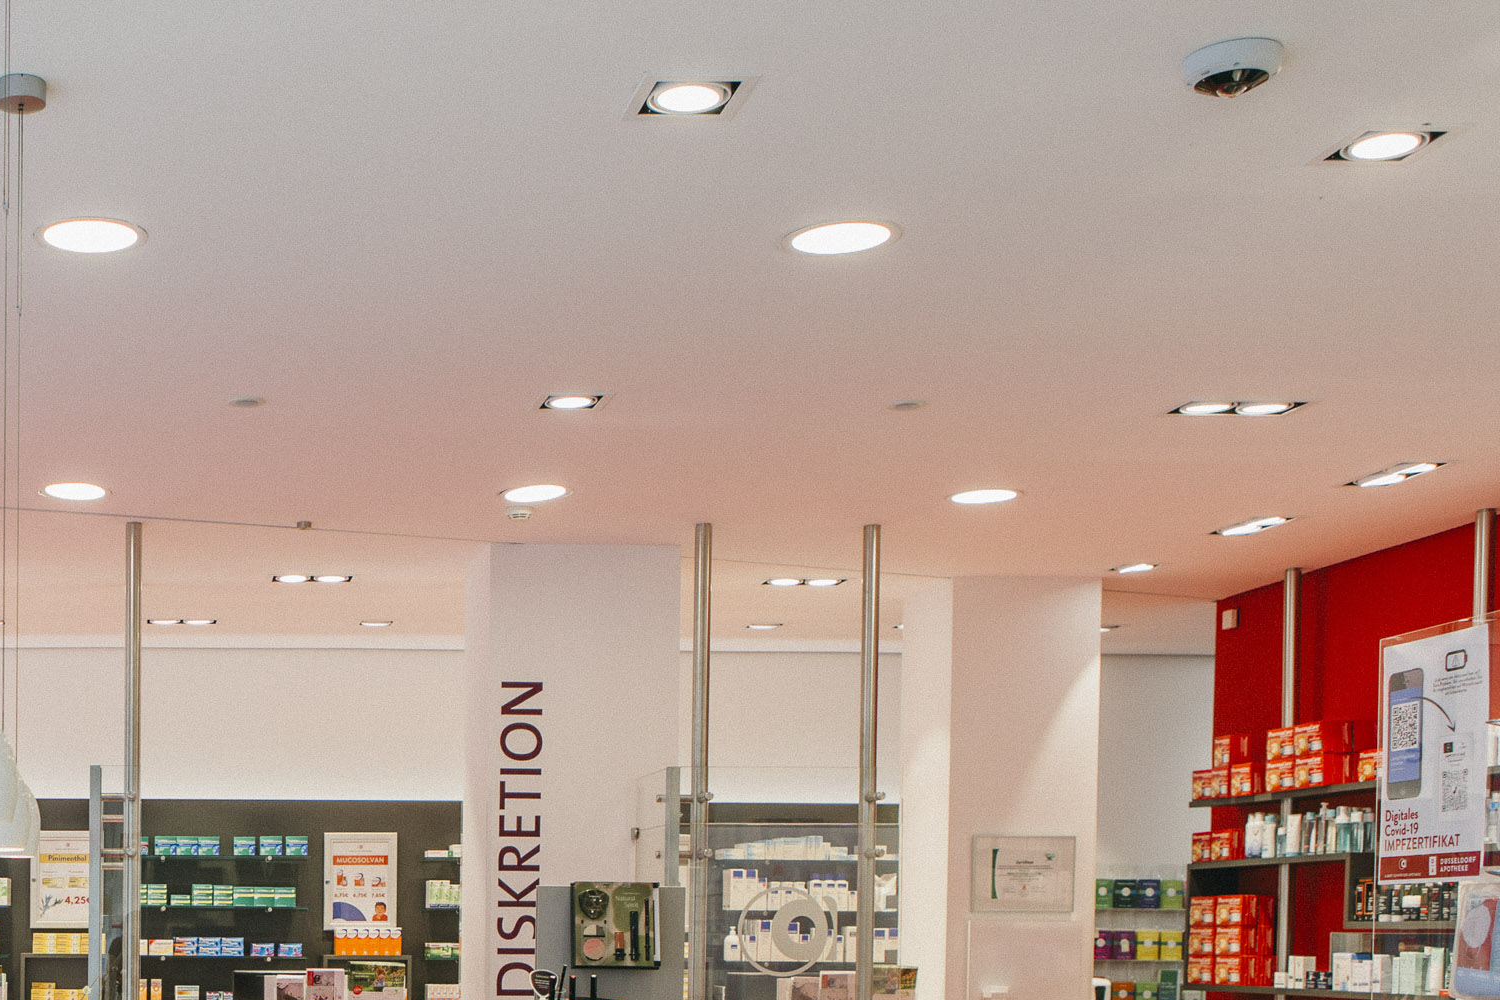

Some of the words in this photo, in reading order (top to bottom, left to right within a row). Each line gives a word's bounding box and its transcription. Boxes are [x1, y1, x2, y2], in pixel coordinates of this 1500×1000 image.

[1385, 808, 1419, 826] Digitales
[496, 681, 544, 996] DISKRETION
[1385, 823, 1419, 837] Covid-19
[1384, 833, 1461, 851] IMPFZERTIFIKAT
[1439, 864, 1469, 873] APOTHEKE
